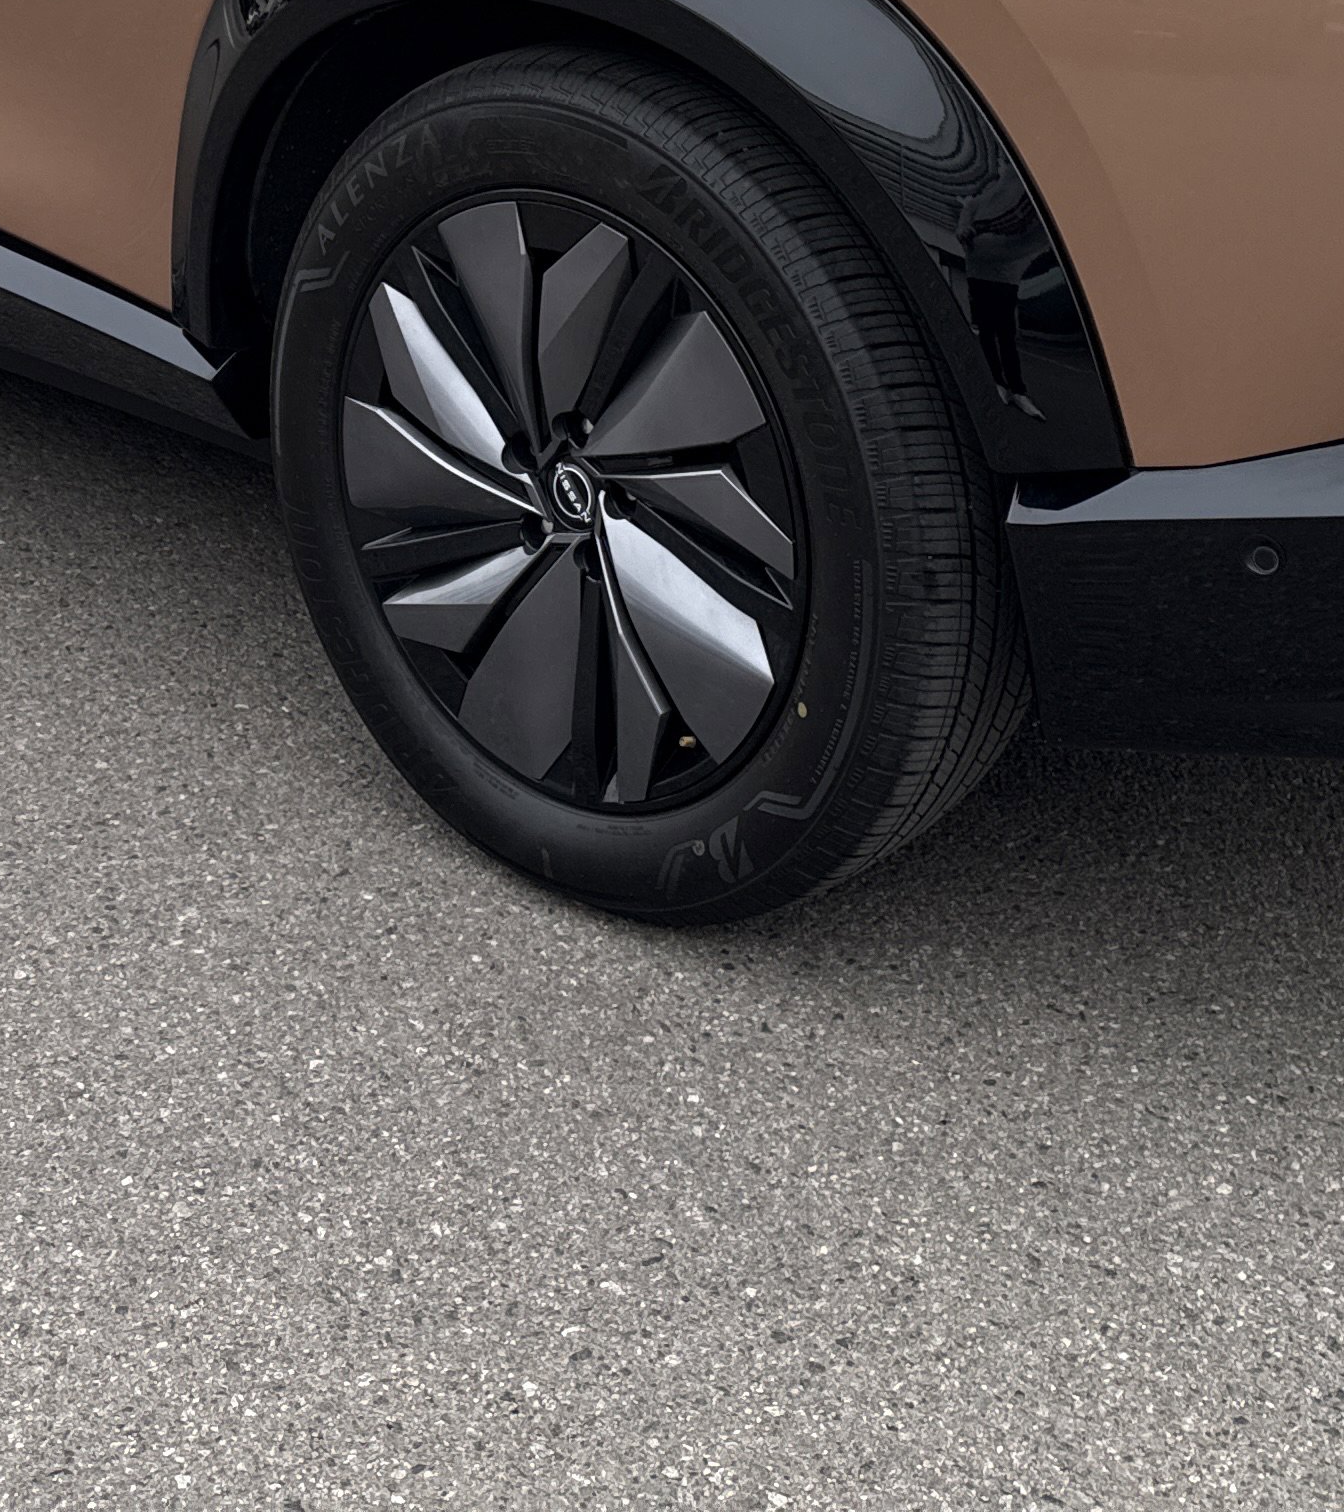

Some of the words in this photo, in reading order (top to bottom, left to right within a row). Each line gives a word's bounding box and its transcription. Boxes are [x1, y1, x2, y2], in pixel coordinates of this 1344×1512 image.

[316, 123, 441, 256] ALENZA
[637, 163, 856, 540] BRIDGESTONE
[556, 462, 591, 523] NISSAN
